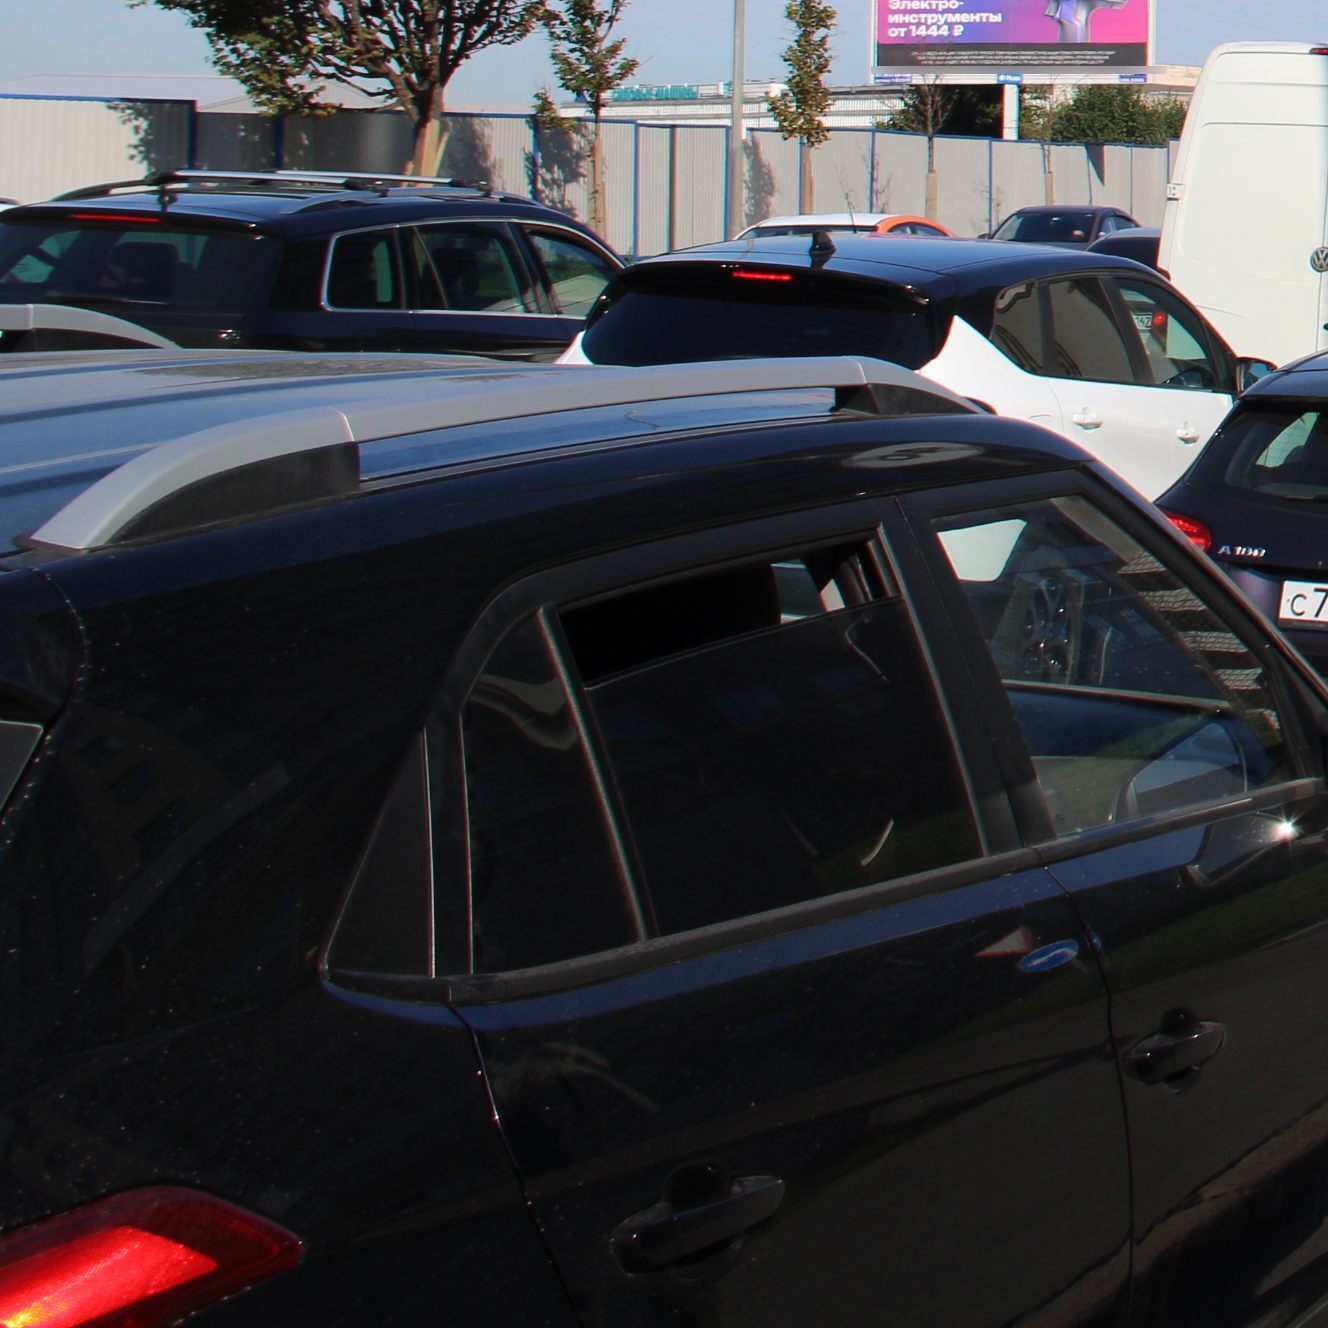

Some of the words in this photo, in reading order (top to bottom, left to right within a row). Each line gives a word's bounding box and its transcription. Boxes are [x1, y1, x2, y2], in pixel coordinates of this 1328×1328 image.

[888, 12, 1002, 25] инструменты
[888, 27, 907, 37] от
[909, 25, 950, 37] 1444
